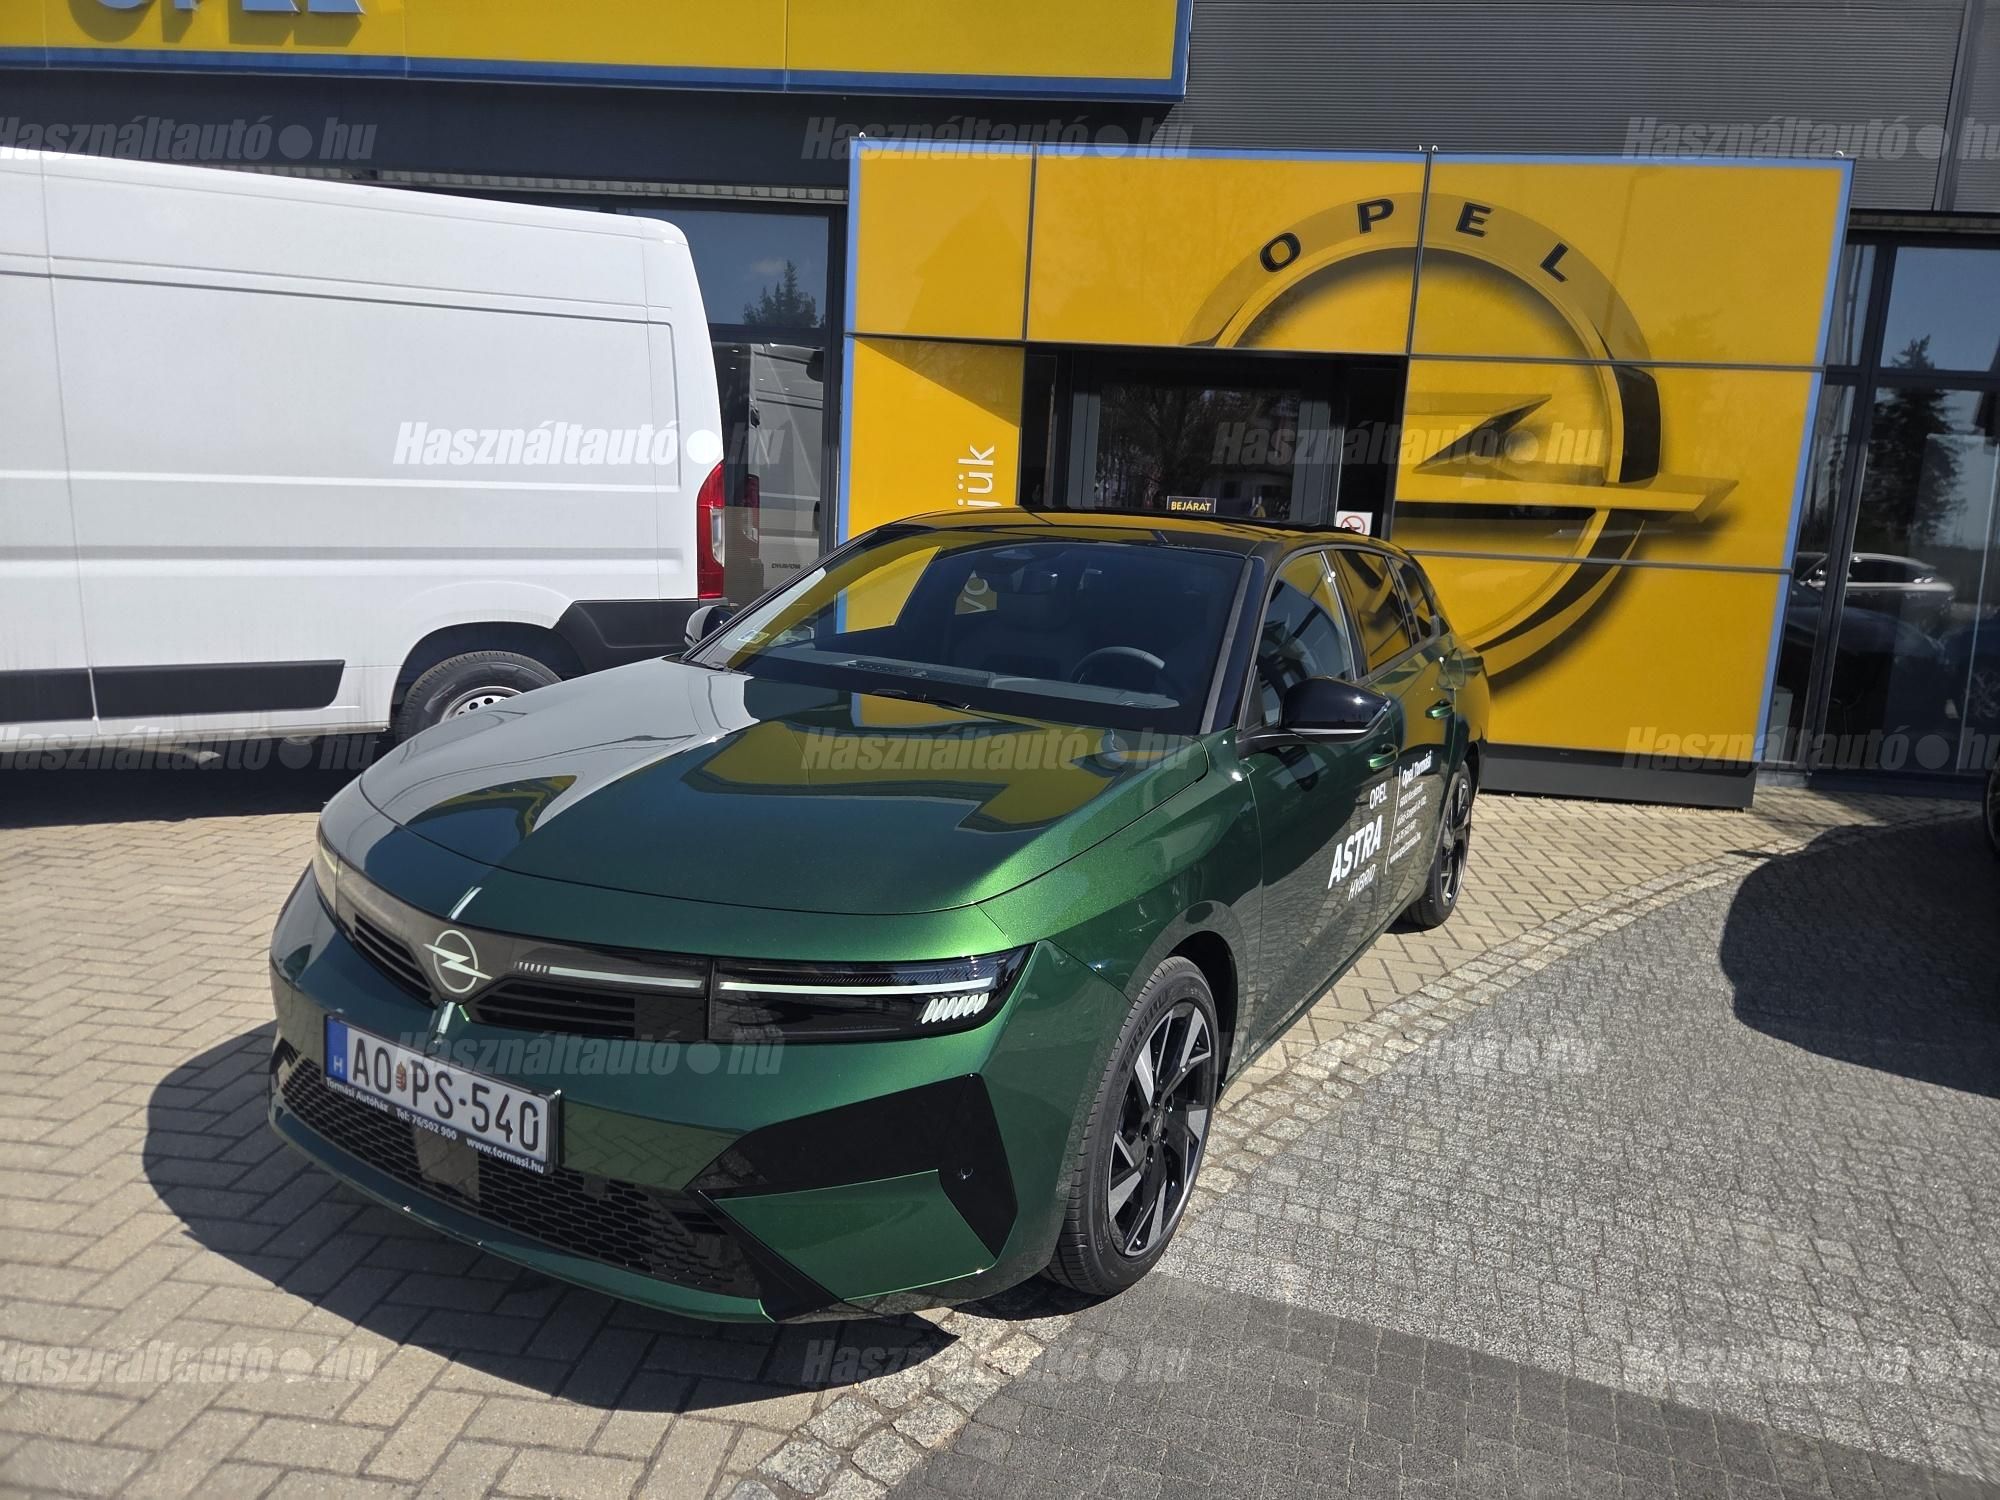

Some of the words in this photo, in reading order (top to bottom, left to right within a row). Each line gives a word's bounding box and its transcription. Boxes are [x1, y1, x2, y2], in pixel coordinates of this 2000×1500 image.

[1259, 197, 1569, 282] OPEL
[1170, 499, 1212, 512] BEJÁRAT
[1369, 781, 1388, 810] OPEL
[1327, 814, 1383, 890] ASTRA
[1348, 863, 1378, 902] HYBRID
[332, 1056, 344, 1074] H
[326, 1077, 355, 1099] Tormási
[355, 1091, 389, 1113] Autóház
[396, 1107, 410, 1122] Tel:
[440, 1126, 457, 1141] 900
[466, 1137, 545, 1174] www.tormasi.hu
